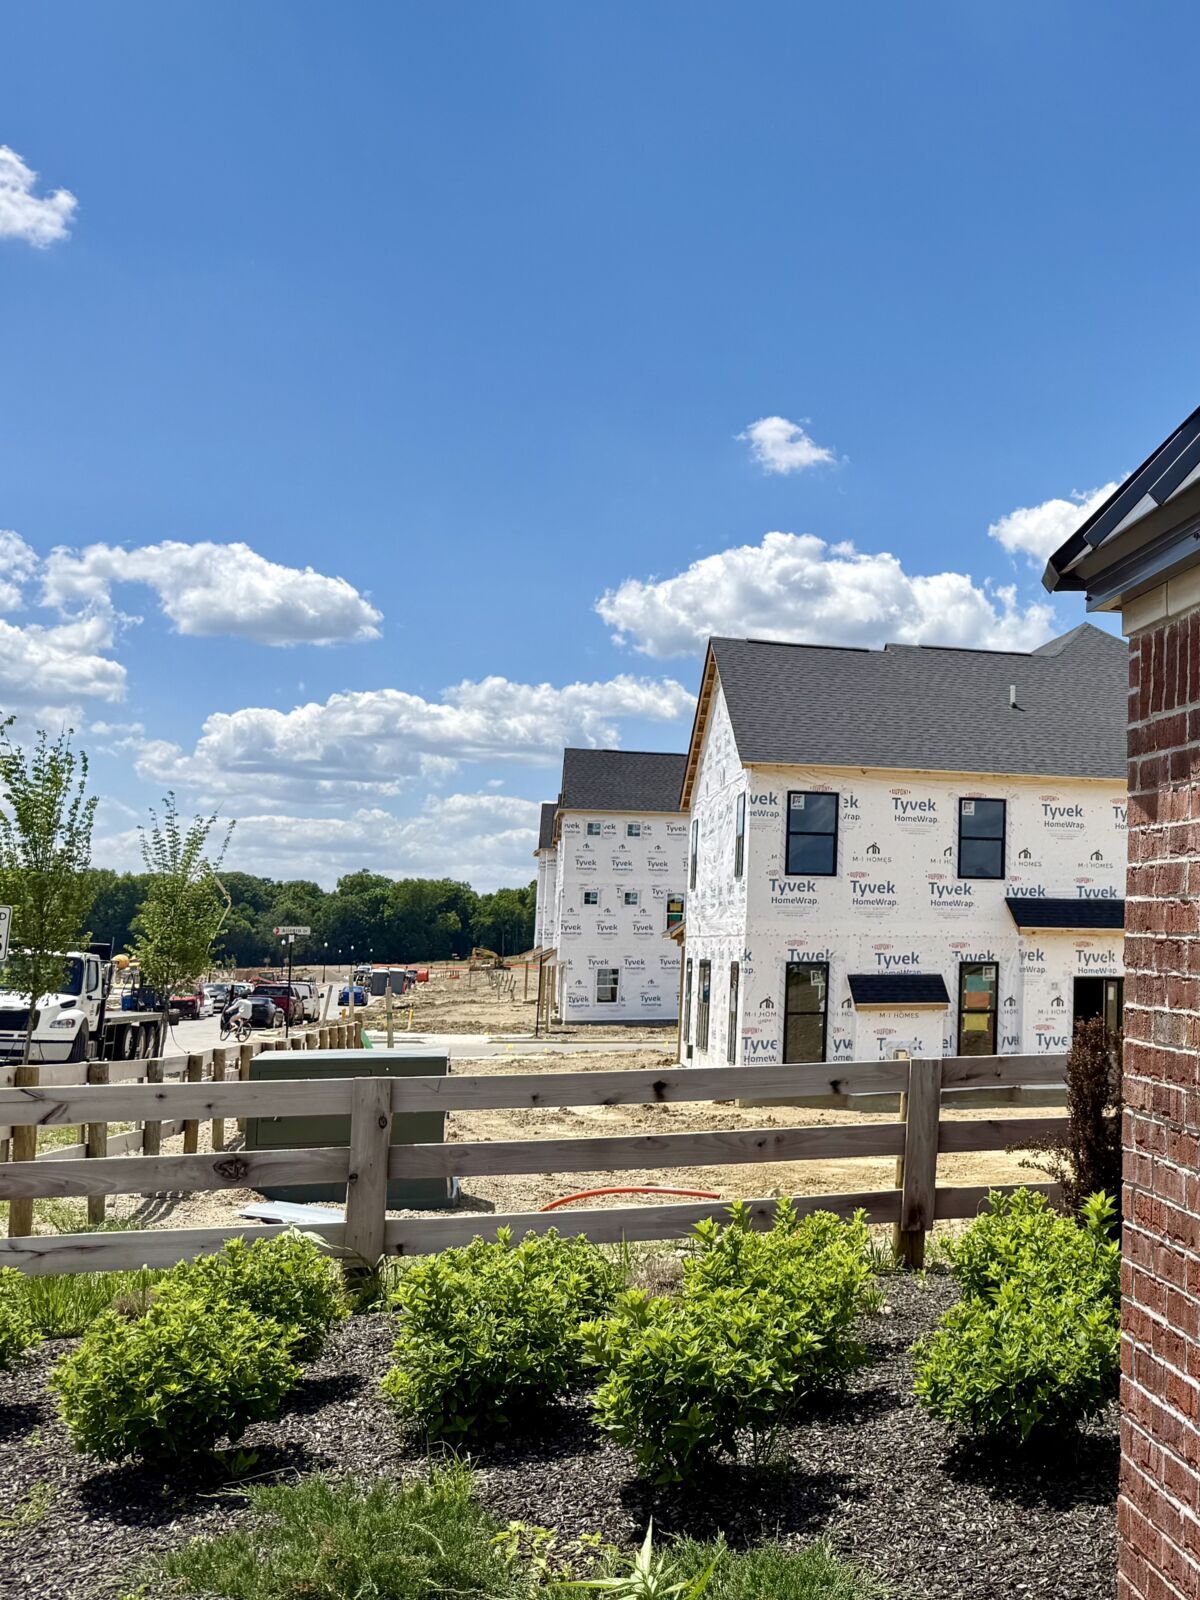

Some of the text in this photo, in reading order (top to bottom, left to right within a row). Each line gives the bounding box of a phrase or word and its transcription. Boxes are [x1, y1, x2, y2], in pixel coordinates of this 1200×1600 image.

[892, 797, 936, 814] Tyvek
[1041, 803, 1083, 820] Tyvek
[894, 814, 938, 824] HomeWrap
[1044, 820, 1085, 829] HomeWrap
[769, 878, 816, 896] Tyvek
[850, 880, 896, 897] Tyvek
[928, 882, 972, 898] Tyvek
[771, 896, 817, 905] HomeWrap
[852, 898, 897, 906] HomeWrap
[930, 899, 974, 908] HomeWrap
[874, 952, 920, 969] Tyvek
[1075, 949, 1116, 966] Tyvek
[742, 1036, 778, 1054] Tyve
[1035, 1033, 1068, 1050] Tyve
[744, 1055, 777, 1063] HomeW
